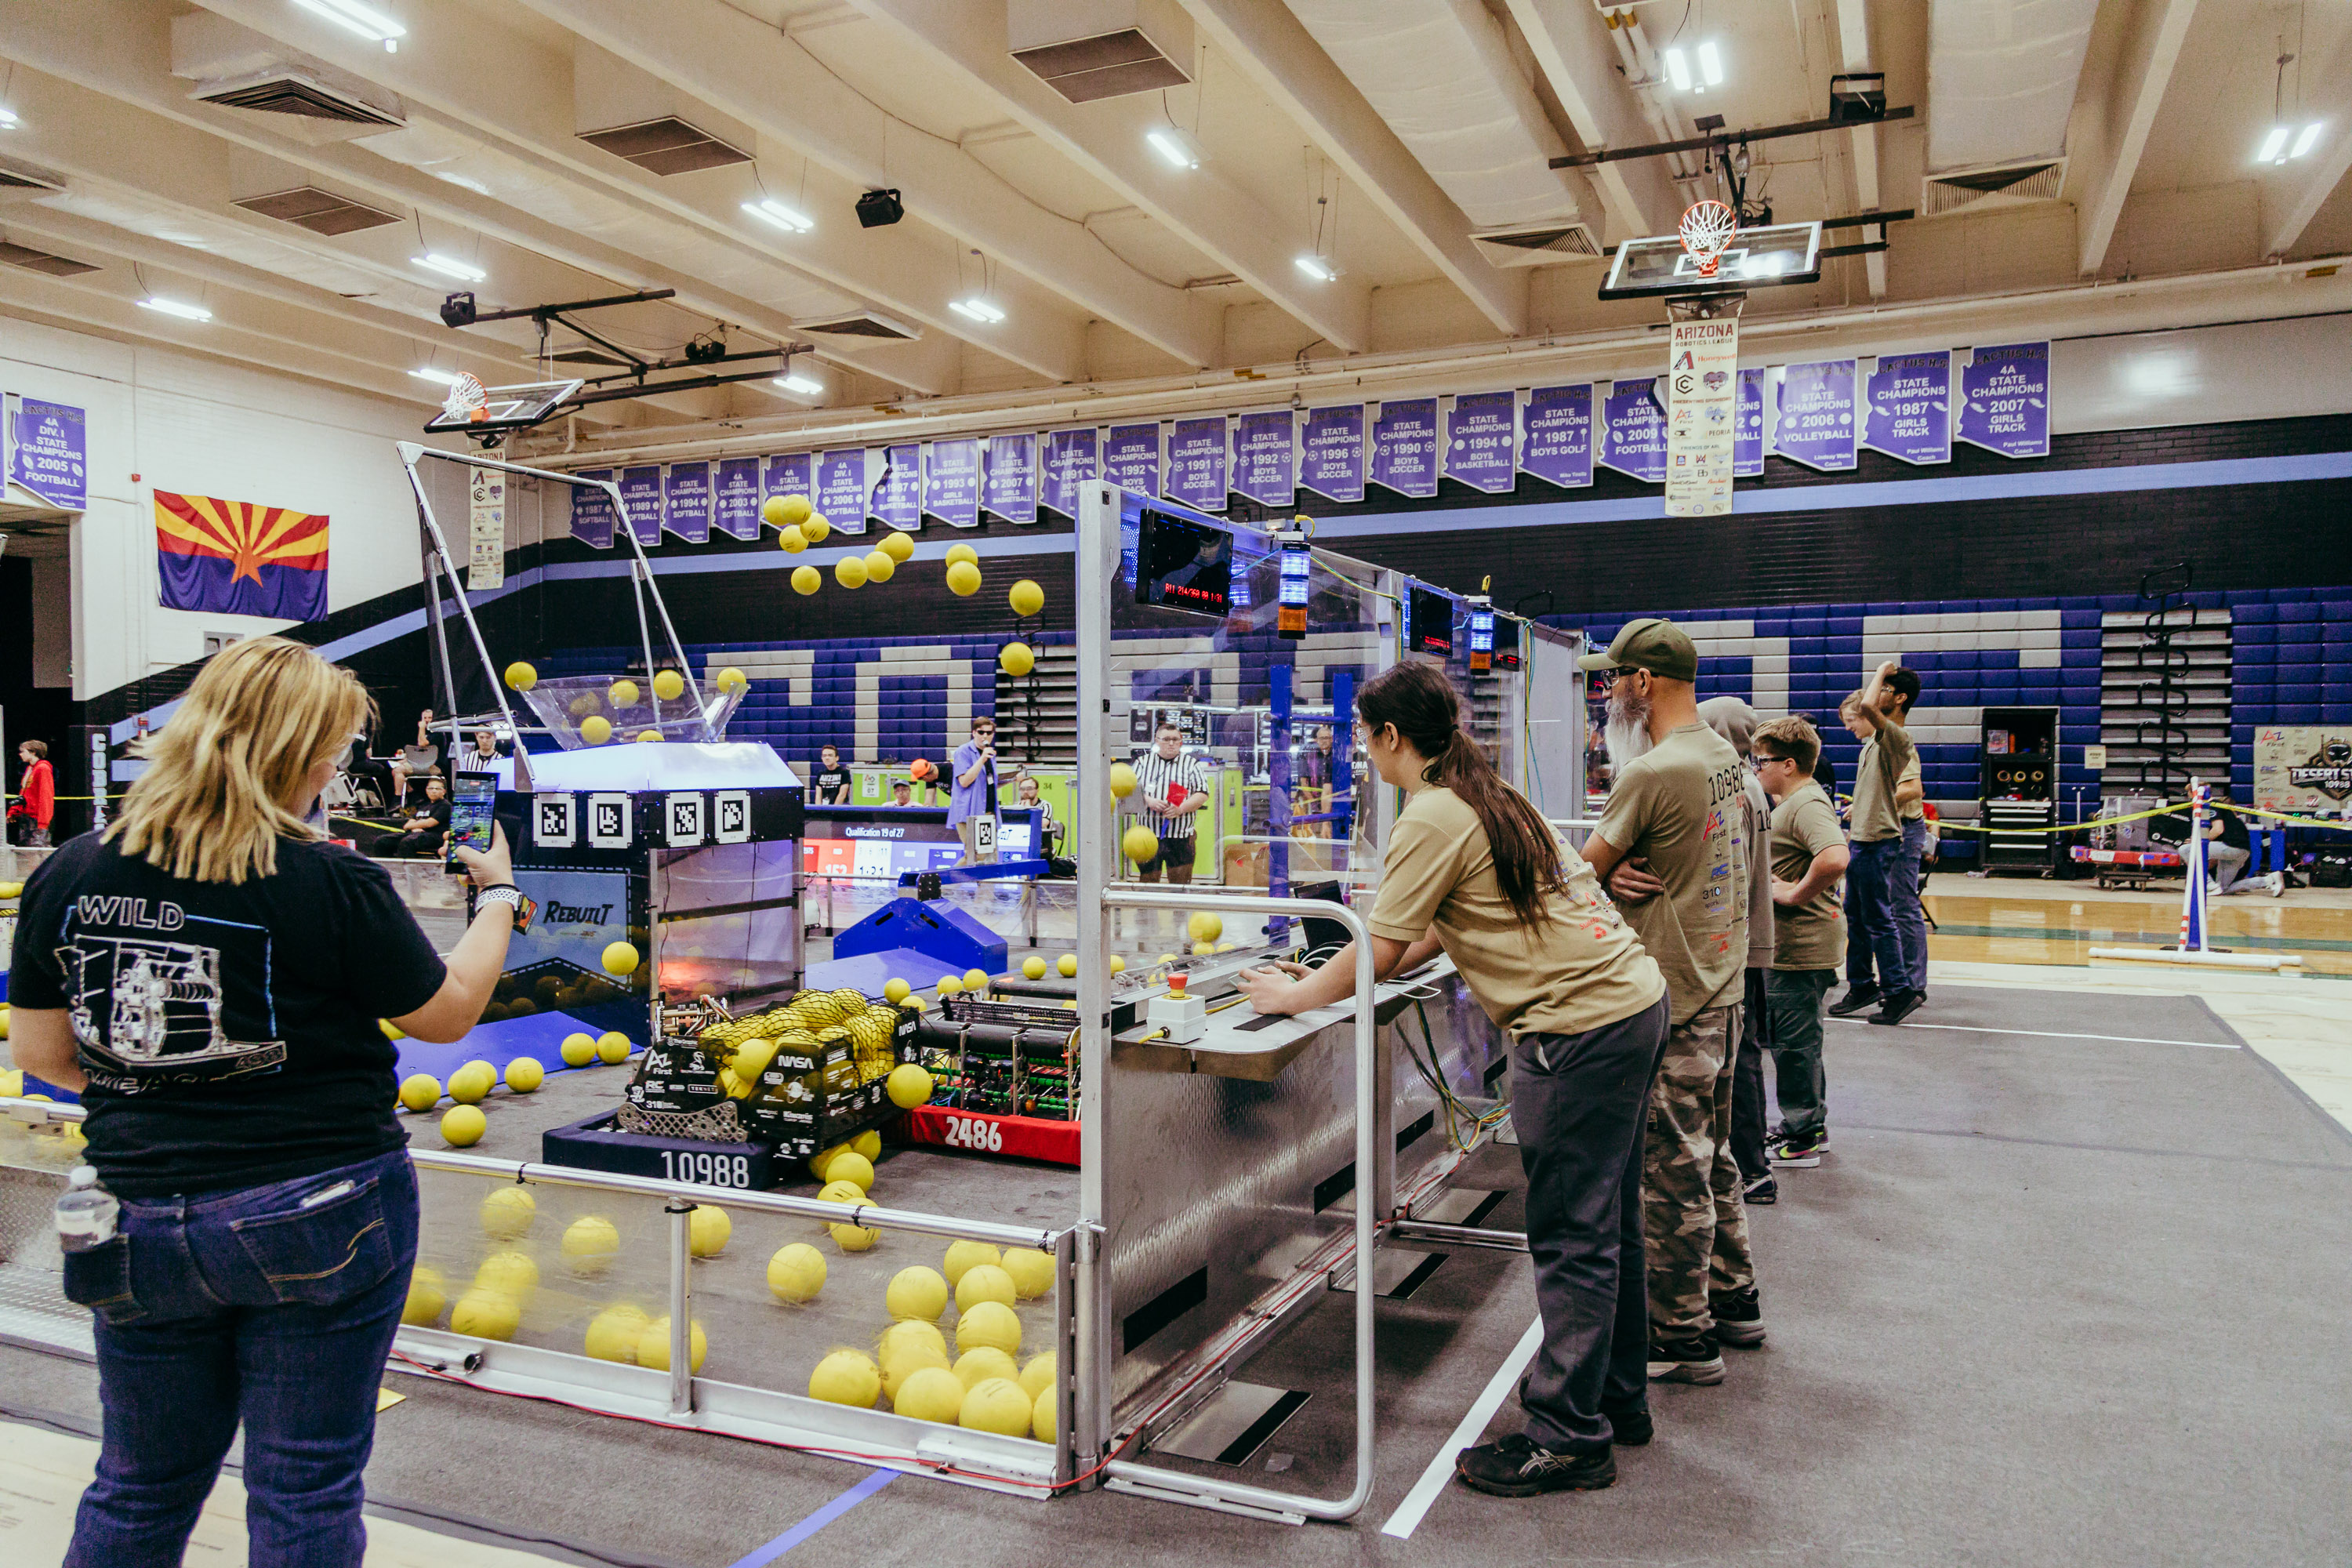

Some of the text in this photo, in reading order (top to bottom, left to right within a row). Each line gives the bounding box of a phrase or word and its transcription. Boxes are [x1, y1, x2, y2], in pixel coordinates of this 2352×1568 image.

[1675, 324, 1733, 339] ARIZONA
[1975, 349, 2022, 365] CACTUS
[1879, 359, 1925, 373] CACTUS
[2000, 365, 2016, 374] 4A
[1894, 377, 1929, 388] STATE
[1990, 375, 2026, 387] STATE
[1878, 386, 1946, 400] CHAMPIONS
[1972, 383, 2044, 397] CHAMPIONS
[1533, 390, 1571, 405] CACTUS
[1636, 397, 1650, 406] 4A
[1802, 391, 1835, 401] STATE
[1628, 406, 1657, 416] STATE
[1785, 399, 1851, 412] CHAMPIONS
[1894, 401, 1929, 416] 1987
[1990, 399, 2026, 413] 2007
[24, 406, 65, 418] CACTUS
[1546, 408, 1574, 418] STATE
[45, 417, 59, 427] 4A
[1469, 416, 1497, 424] STATE
[1531, 416, 1589, 428] CHAMPIONS
[1802, 414, 1835, 427] 2006
[1895, 418, 1927, 428] GIRLS
[1991, 414, 2024, 424] GIRLS
[1394, 421, 1421, 430] STATE
[1456, 423, 1511, 434] CHAMPIONS
[1988, 423, 2026, 434] TRACK
[40, 426, 65, 438] DIV. I
[1252, 433, 1278, 441] STATE
[1322, 427, 1348, 437] STATE
[1381, 429, 1434, 440] CHAMPIONS
[1545, 431, 1574, 443] 1987
[1628, 428, 1657, 441] 2009
[1784, 430, 1852, 442] VOLLEYBALL
[1893, 426, 1929, 437] TRACK
[37, 437, 67, 449] STATE
[1187, 439, 1212, 448] STATE
[1309, 434, 1361, 446] CHAMPIONS
[1469, 437, 1497, 449] 1994
[22, 443, 82, 460] CHAMPIONS
[1122, 445, 1145, 453] STATE
[1175, 446, 1224, 456] CHAMPIONS
[1240, 441, 1290, 451] CHAMPIONS
[1393, 443, 1421, 454] 1990
[1531, 445, 1587, 456] BOYS GOLF
[1110, 452, 1156, 463] CHAMPIONS
[1322, 448, 1348, 459] 1996
[37, 457, 68, 472] 2005
[1050, 457, 1094, 467] CHAMPIONS
[1187, 459, 1210, 470] 1991
[1252, 454, 1278, 465] 1992
[1456, 459, 1510, 469] BASKETBALL
[933, 466, 975, 476] CHAMPIONS
[990, 466, 1033, 476] CHAMPIONS
[1062, 469, 1082, 480] 1991
[1122, 465, 1145, 476] 1992
[1317, 470, 1352, 479] SOCCER
[1389, 465, 1425, 474] SOCCER
[25, 471, 80, 488] FOOTBALL
[943, 478, 964, 488] 1993
[1001, 477, 1023, 488] 2007
[1123, 477, 1144, 486] BOYS
[1183, 481, 1215, 489] SOCCER
[1249, 475, 1282, 484] SOCCER
[671, 487, 707, 495] CHAMPIONS
[720, 488, 757, 496] CHAMPIONS
[770, 484, 809, 492] CHAMPIONS
[823, 485, 862, 494] CHAMPIONS
[680, 498, 699, 508] 1994
[729, 497, 748, 507] 2003
[833, 494, 853, 505] 2006
[933, 498, 975, 506] BASKETBALL
[993, 495, 1032, 504] BASKETBALL
[632, 502, 650, 510] 1989
[879, 502, 917, 510] BASKETBALL
[673, 510, 706, 518] SOFTBALL
[722, 510, 754, 518] SOFTBALL
[2291, 768, 2339, 784] DESERT
[845, 827, 905, 837] Qualification 19 of 27
[78, 895, 185, 931] WILD
[898, 1021, 916, 1036] NASA
[778, 1054, 815, 1069] NASA
[945, 1116, 1003, 1152] 2486
[659, 1150, 750, 1189] 10988
